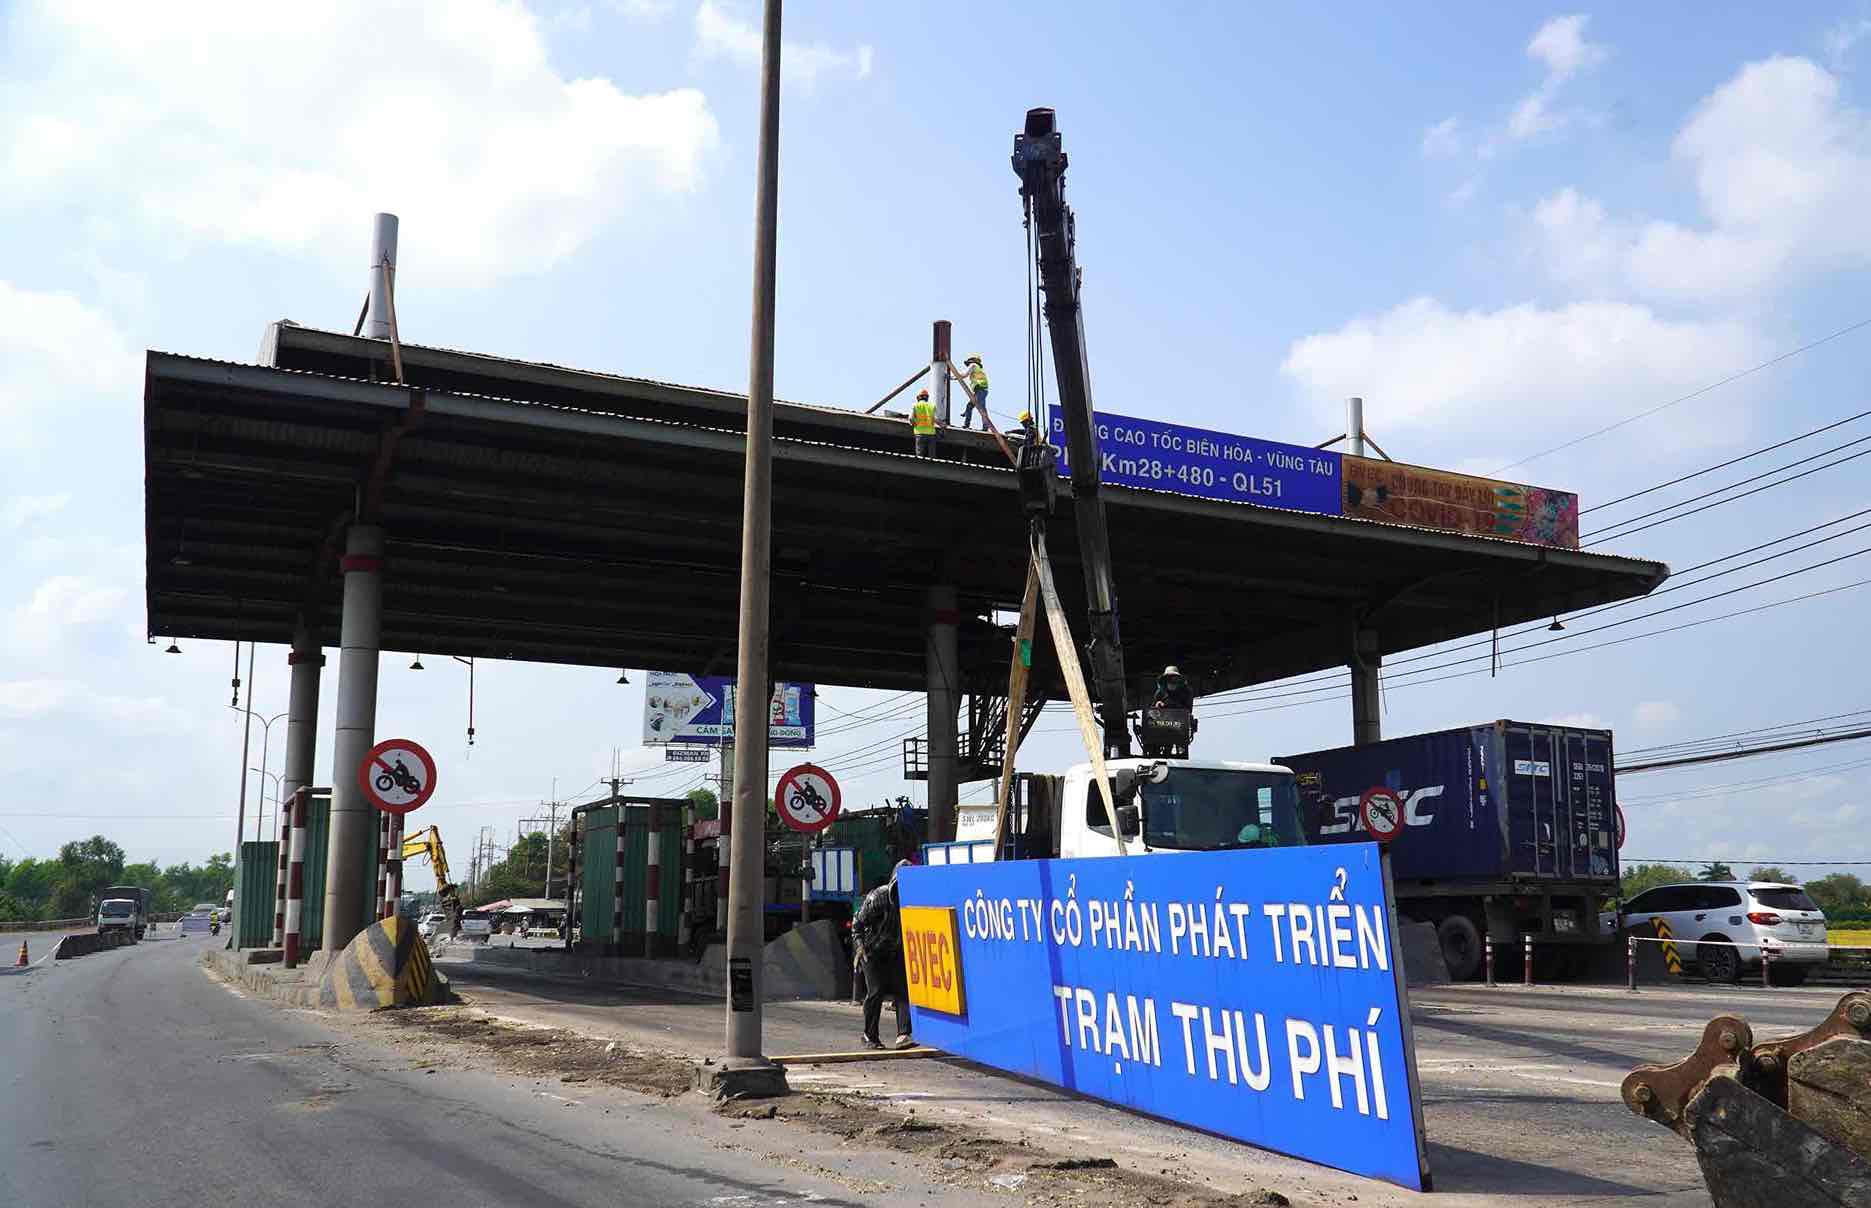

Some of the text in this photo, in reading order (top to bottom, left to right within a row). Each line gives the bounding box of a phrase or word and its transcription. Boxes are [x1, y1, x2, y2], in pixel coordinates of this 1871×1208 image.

[1114, 428, 1145, 445] CAO
[1151, 429, 1182, 451] TỐC
[1186, 438, 1219, 458] BIÊN
[1224, 443, 1253, 463] HÒA
[1266, 451, 1304, 471] VŨNG
[1309, 457, 1334, 476] TÀU
[1233, 472, 1282, 497] QL51
[964, 866, 1388, 971] CÔNG TY CỔ PHẦN PHÁT TRIỂN
[906, 929, 952, 992] BVEC
[1053, 984, 1389, 1120] TRẠM THU PHÍ
